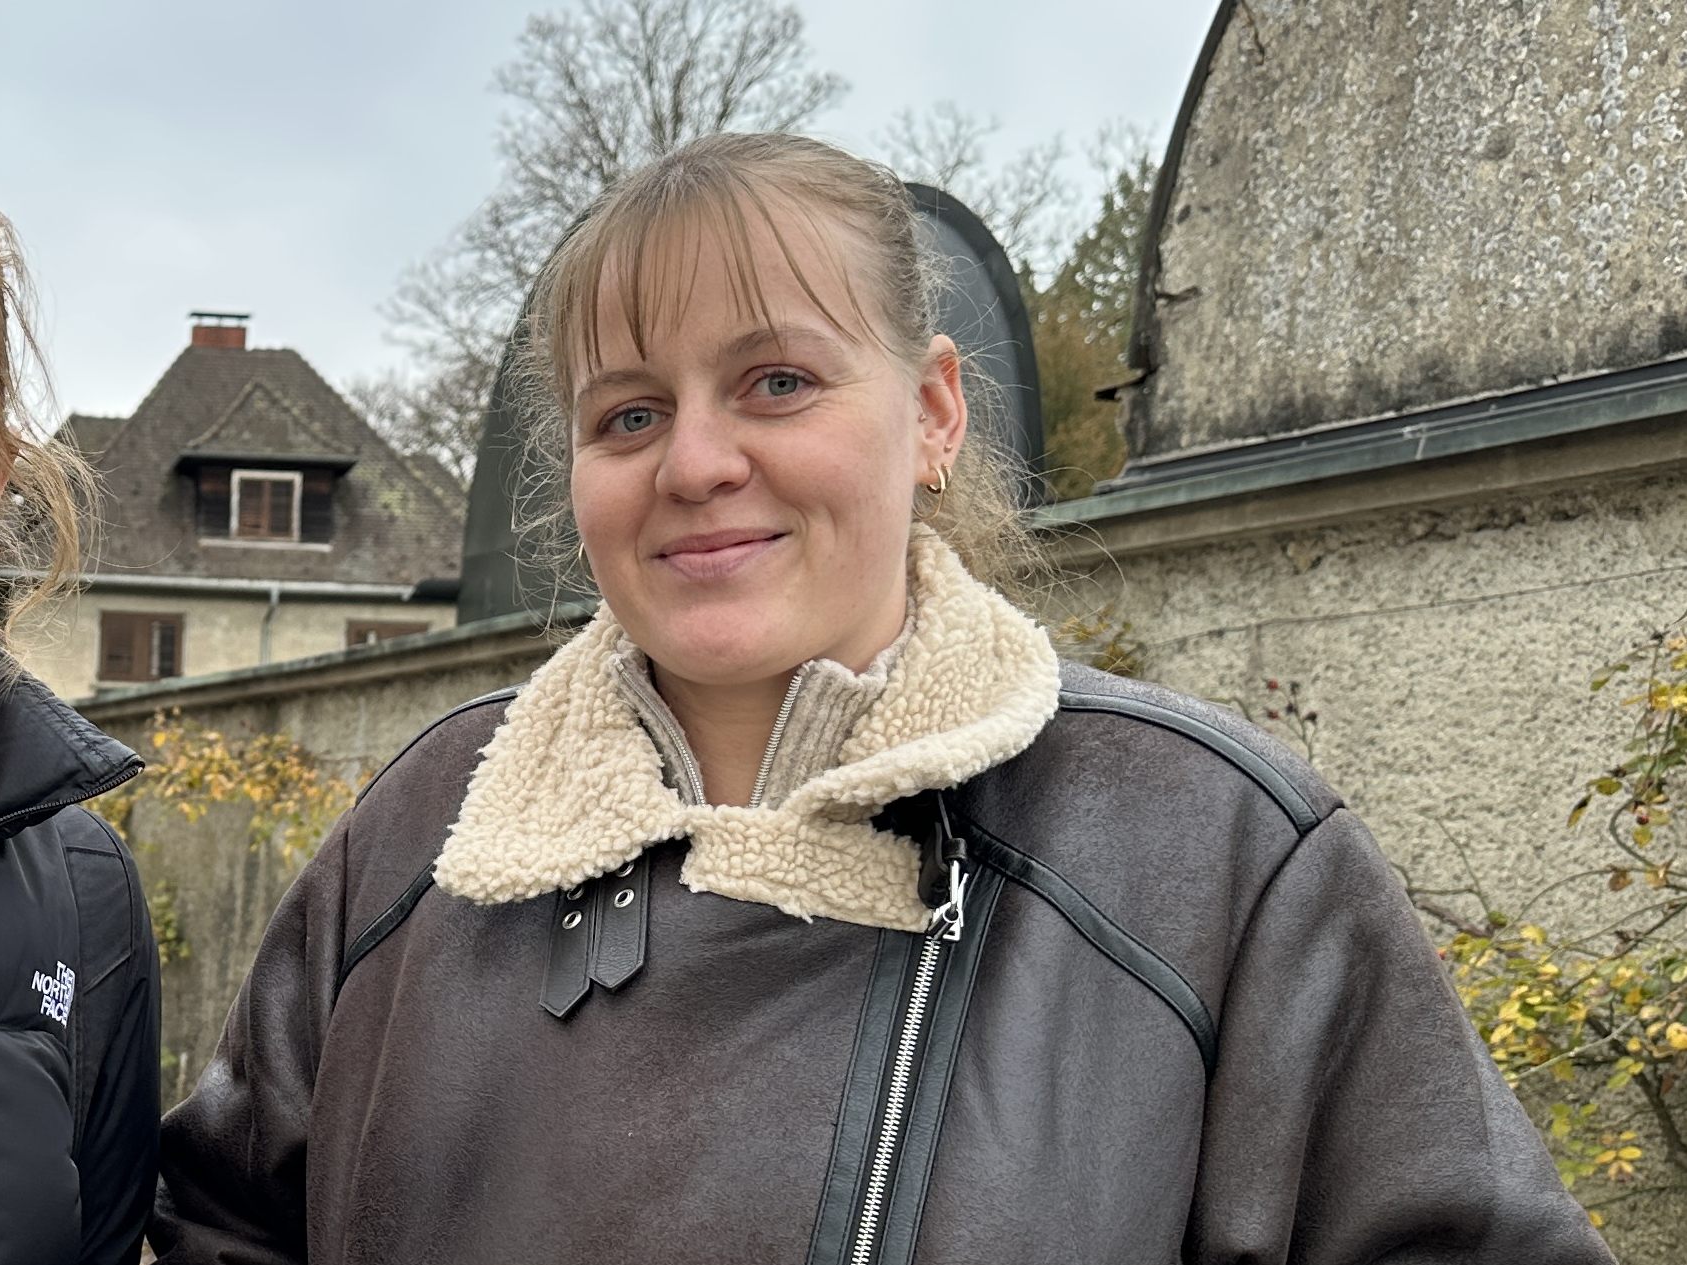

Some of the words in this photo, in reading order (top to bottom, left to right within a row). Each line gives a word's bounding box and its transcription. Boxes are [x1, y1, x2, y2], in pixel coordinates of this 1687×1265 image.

[31, 970, 74, 1006] NORTH
[56, 960, 75, 985] THE
[40, 994, 68, 1029] FACE
